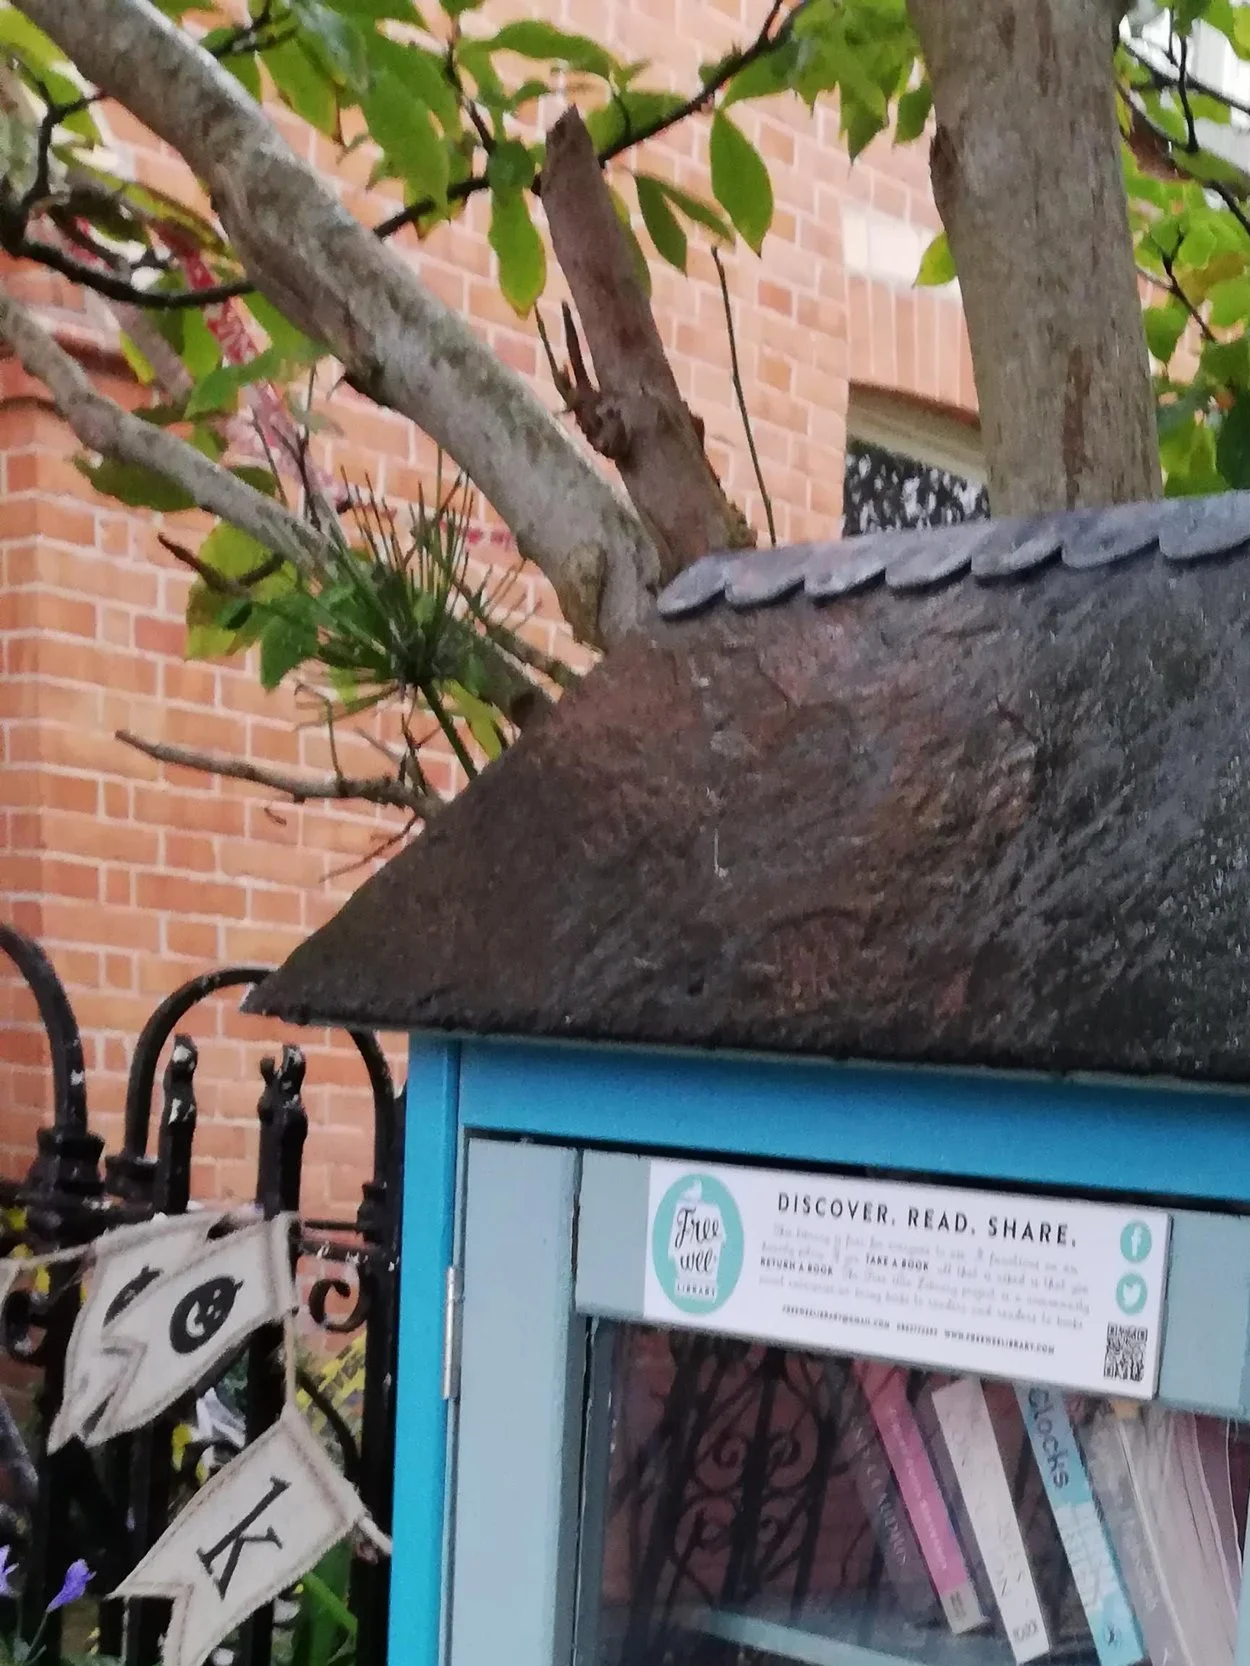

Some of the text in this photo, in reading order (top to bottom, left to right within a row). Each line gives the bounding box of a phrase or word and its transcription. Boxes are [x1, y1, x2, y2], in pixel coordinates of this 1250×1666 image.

[674, 1206, 719, 1249] Free
[777, 1191, 1078, 1249] DISCOVER. READ. SHARE.
[865, 1252, 888, 1266] TAKE
[891, 1257, 898, 1267] A
[196, 1476, 291, 1599] K
